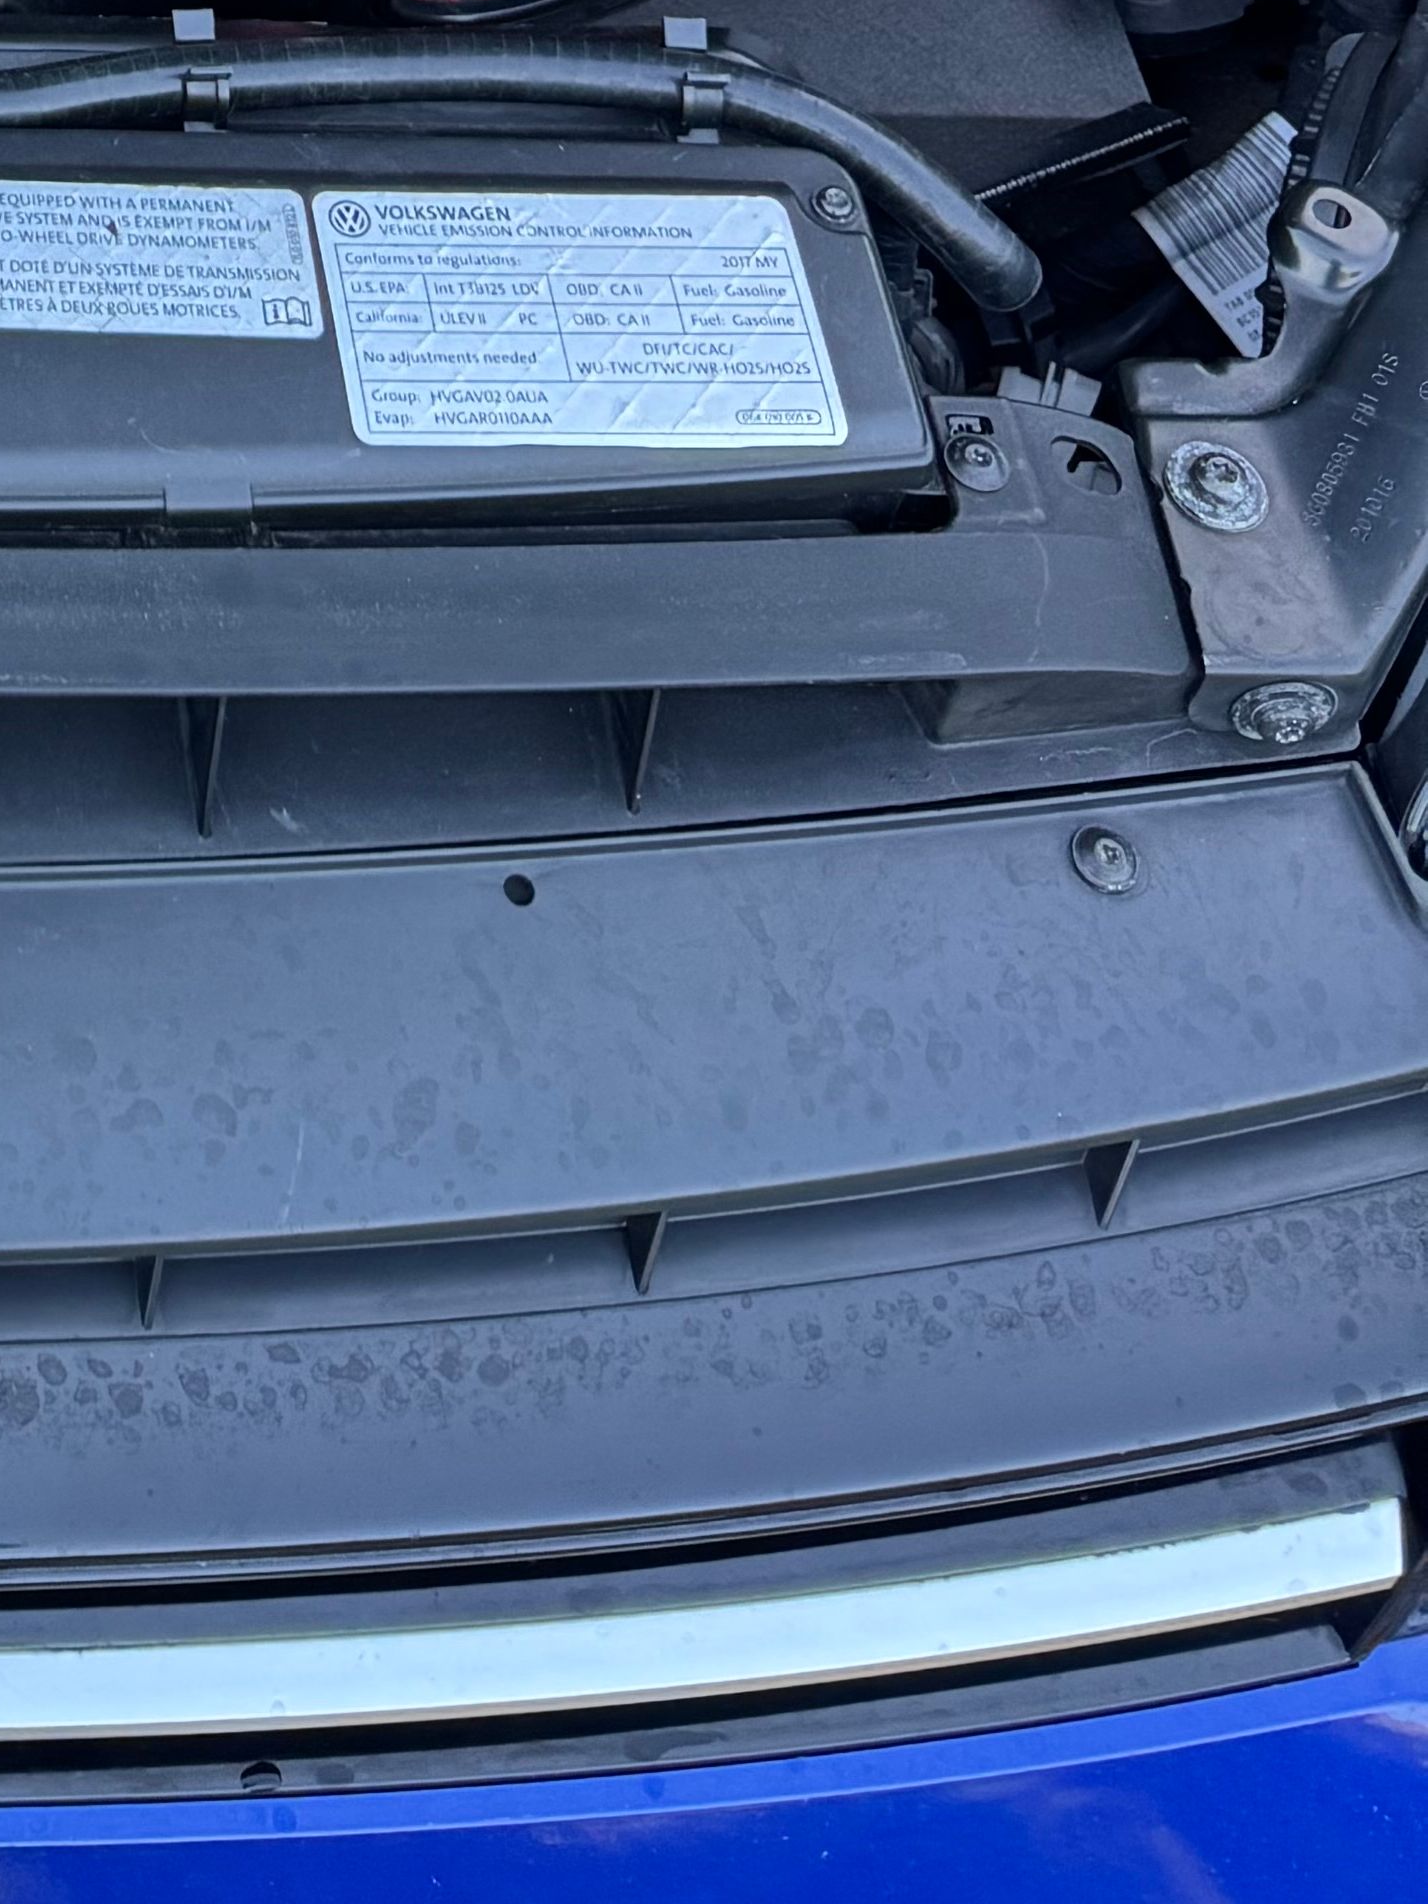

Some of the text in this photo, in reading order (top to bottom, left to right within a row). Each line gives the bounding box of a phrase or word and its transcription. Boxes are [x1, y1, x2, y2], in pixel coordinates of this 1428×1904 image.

[0, 192, 76, 208] EQUIPPED
[79, 196, 121, 209] WITH
[123, 195, 137, 210] A
[141, 198, 234, 213] PERMANENT
[374, 205, 511, 221] VOLKSWAGEN
[16, 212, 73, 226] SYSTEM
[78, 214, 114, 228] AND
[116, 214, 131, 228] IS
[135, 215, 192, 230] EXEMPT
[198, 218, 241, 231] FROM
[243, 217, 272, 232] I/M
[378, 224, 694, 240] VEHICLE EMISSION CONTROL INFORMATION
[77, 232, 122, 246] DRIVE
[128, 233, 260, 250] DYNAMOMETERS.
[345, 252, 521, 269] Conforms to regulations:
[718, 254, 781, 269] 2017 MY
[10, 259, 49, 274] DOTÉ
[54, 261, 92, 275] D'UN
[95, 262, 159, 277] SYSTÈME
[164, 264, 184, 279] DE
[187, 266, 300, 282] TRANSMISSION
[57, 279, 76, 294] ET
[79, 279, 143, 296] EXEMPTÉ
[147, 283, 210, 298] D'ESSAIS
[432, 280, 456, 295] Int
[564, 282, 644, 297] OBD: CA II
[681, 282, 786, 297] Fuel: Gasoline
[44, 295, 58, 313] À
[61, 299, 103, 315] DEUX
[107, 300, 159, 316] ROUES
[163, 303, 241, 318] MOTRICES.
[356, 310, 421, 323] California:
[517, 312, 539, 326] PC
[572, 312, 652, 327] OBD: CA II
[688, 311, 794, 327] Fuel: Gasoline
[361, 349, 542, 366] No adjustments needed.
[371, 389, 421, 406] Group:
[375, 411, 413, 427] Evap:
